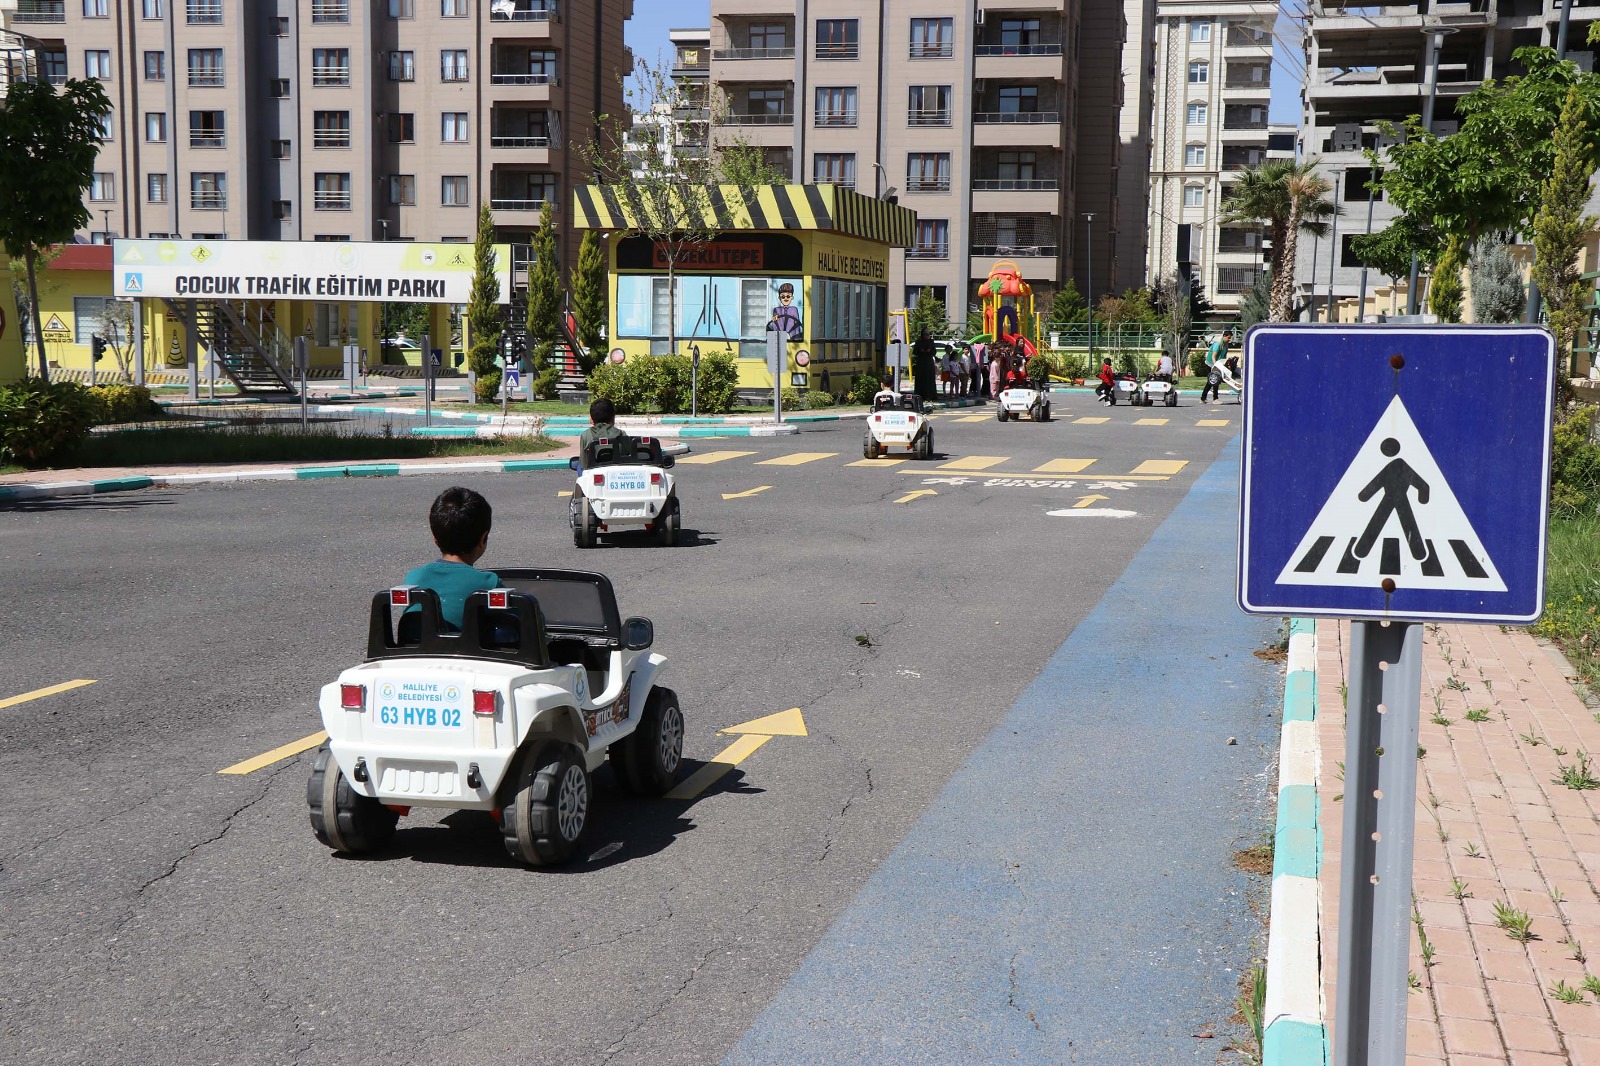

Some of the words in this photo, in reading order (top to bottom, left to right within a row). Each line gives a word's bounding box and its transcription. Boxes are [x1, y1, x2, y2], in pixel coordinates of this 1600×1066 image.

[818, 249, 848, 274] HALİLİYE
[850, 256, 885, 279] BELEDİYESİ
[175, 275, 240, 296] ÇOCUK
[245, 274, 311, 295] TRAFİK
[316, 274, 382, 297] EĞİTİM
[387, 278, 446, 298] PARKI
[610, 481, 619, 490] 63
[620, 481, 635, 489] HYB
[636, 481, 645, 489] 08
[403, 683, 438, 692] HALİLİYE
[398, 692, 442, 702] BELEDİYESİ
[380, 706, 398, 725] 63
[403, 707, 437, 726] HYB
[441, 708, 461, 727] 02
